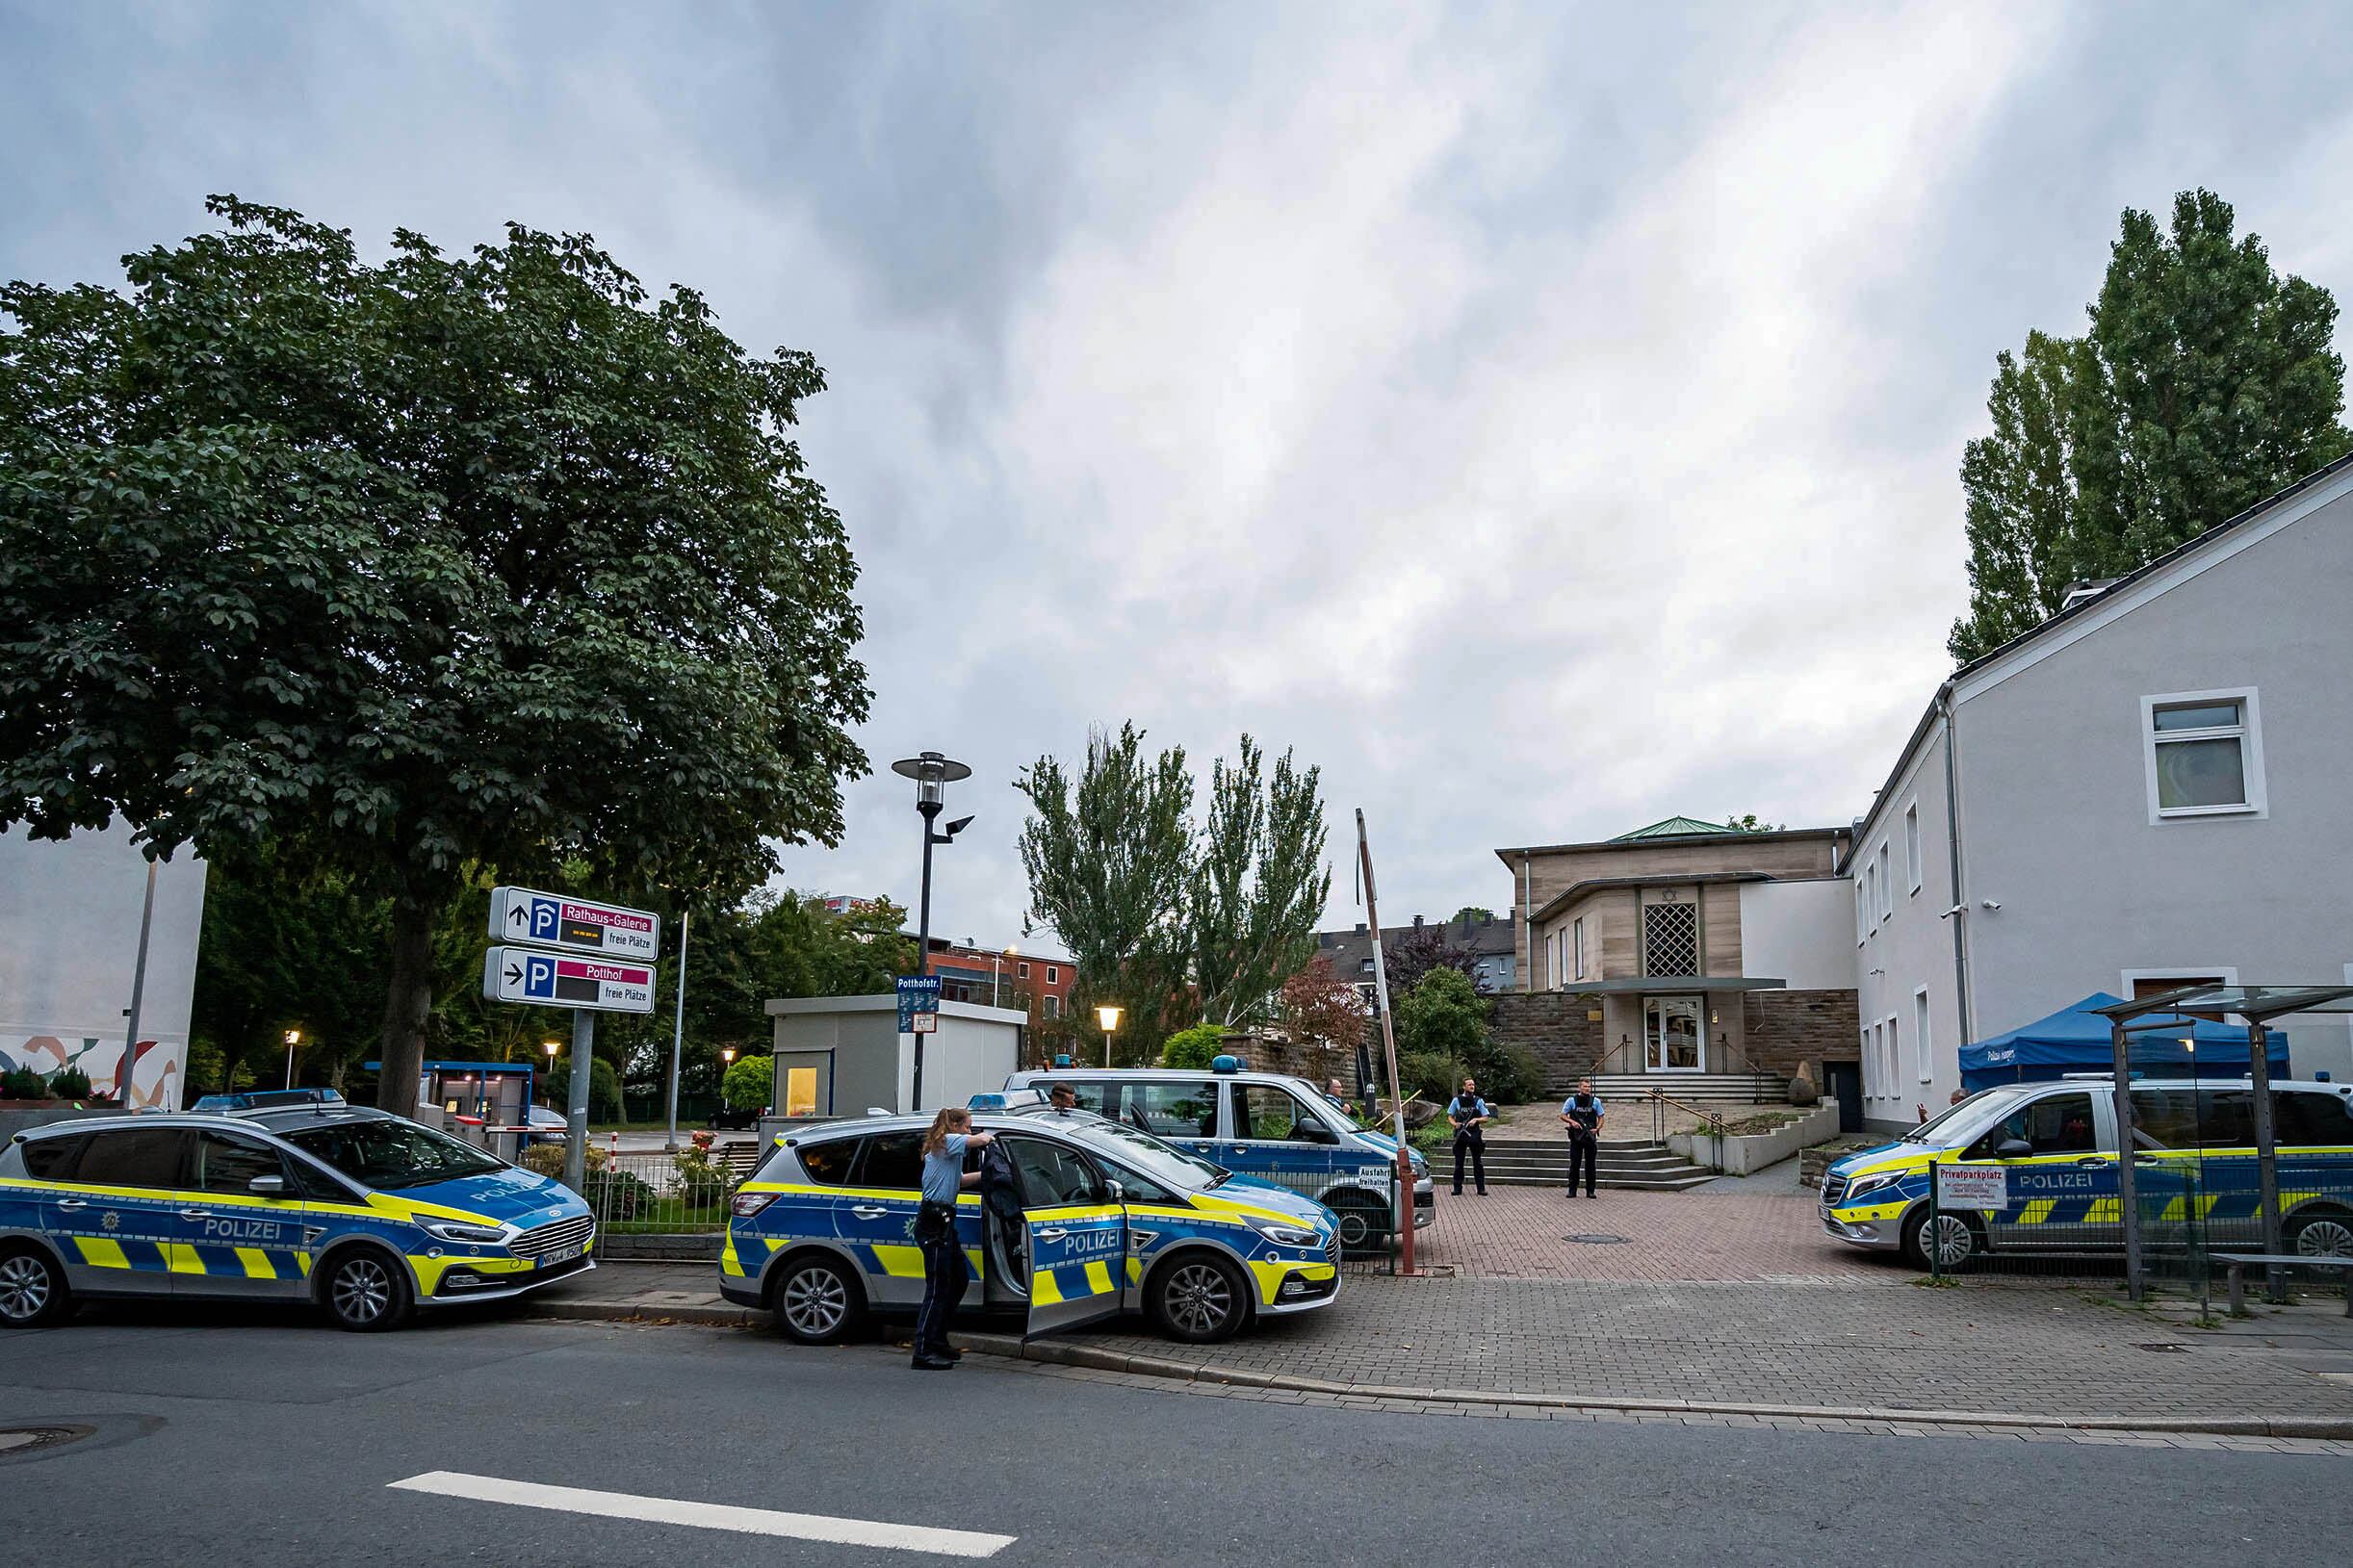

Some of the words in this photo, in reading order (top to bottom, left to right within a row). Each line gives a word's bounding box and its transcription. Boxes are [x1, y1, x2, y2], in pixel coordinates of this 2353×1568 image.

[536, 912, 553, 935] P
[567, 906, 648, 931] Rathaus-Galerie
[609, 933, 627, 945] freie
[629, 935, 650, 949] Plätze
[530, 964, 549, 990] P
[586, 965, 623, 981] Potthof
[898, 978, 939, 988] Potthofstr.
[606, 987, 623, 999] freie
[625, 988, 647, 1001] Plätze
[1360, 1169, 1390, 1177] Ausfahrt
[1940, 1169, 2003, 1181] Privatparkplatz
[2020, 1173, 2093, 1189] POLIZEI
[204, 1219, 281, 1240] POLIZEI
[1065, 1229, 1121, 1255] POLIZEI
